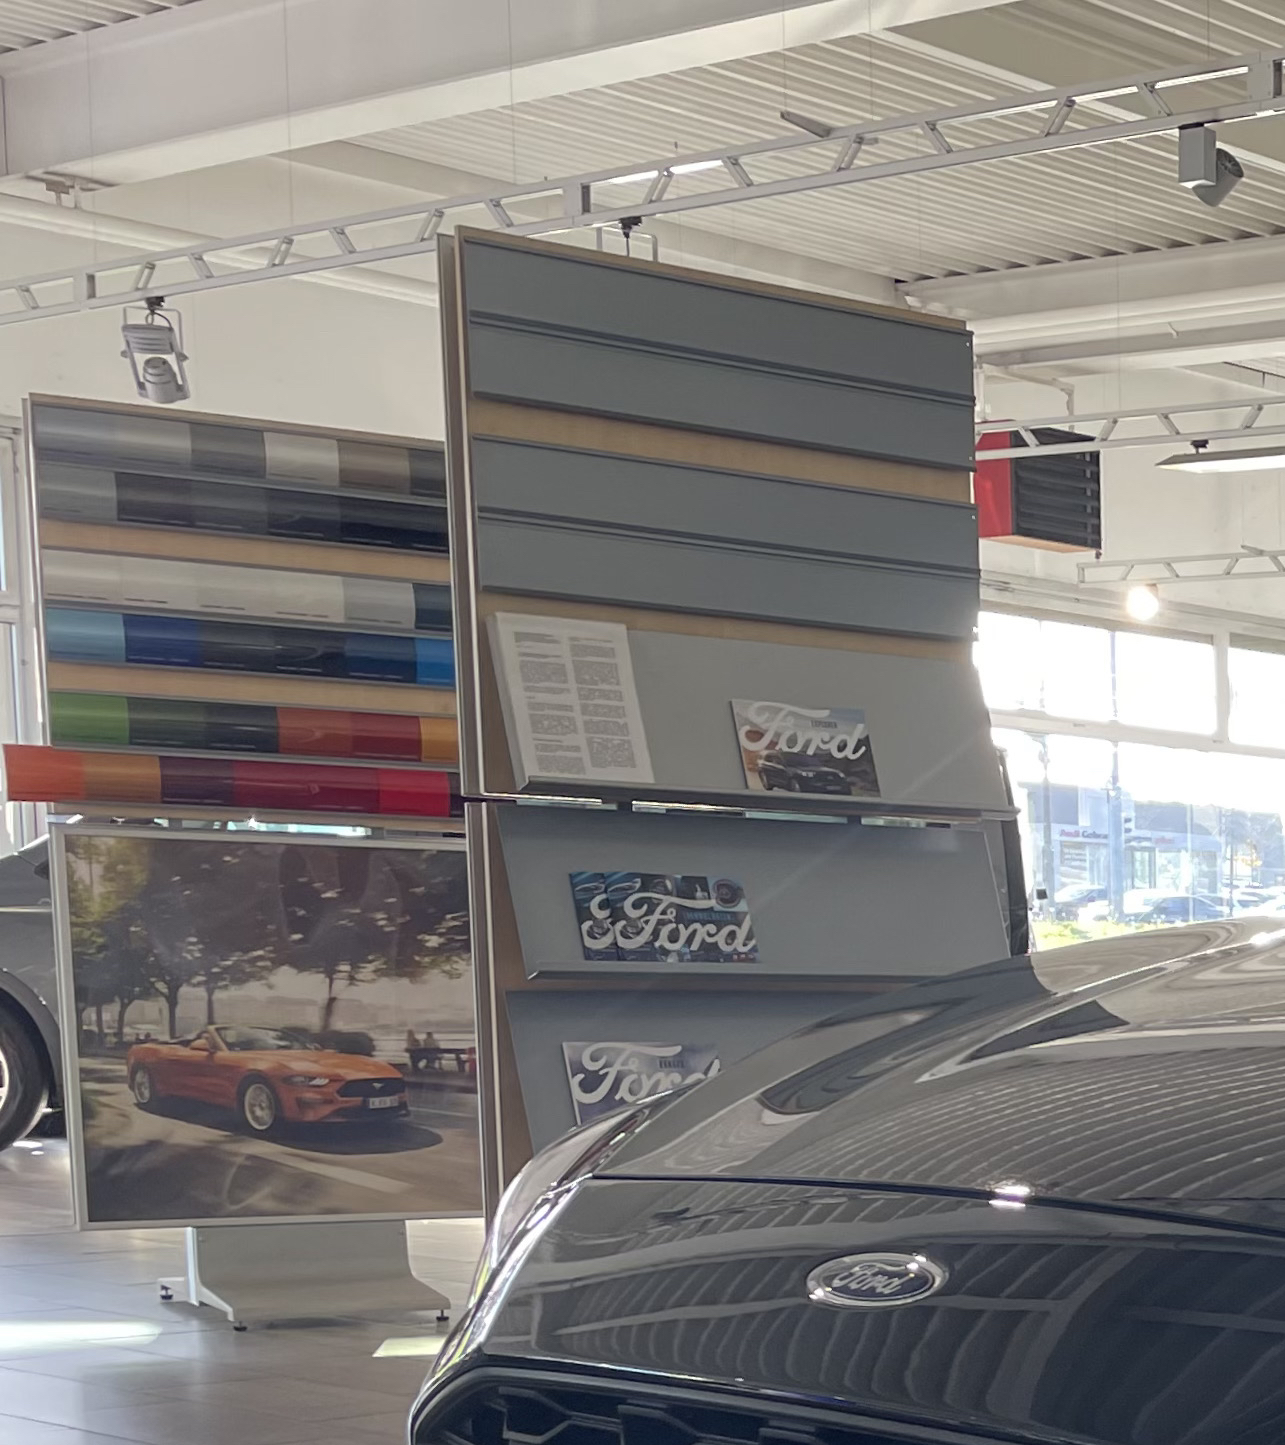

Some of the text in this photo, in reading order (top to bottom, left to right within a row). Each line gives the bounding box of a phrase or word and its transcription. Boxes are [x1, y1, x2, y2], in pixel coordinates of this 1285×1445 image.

[740, 701, 867, 760] Ford
[615, 892, 756, 952] Ford
[831, 1262, 913, 1294] Ford
